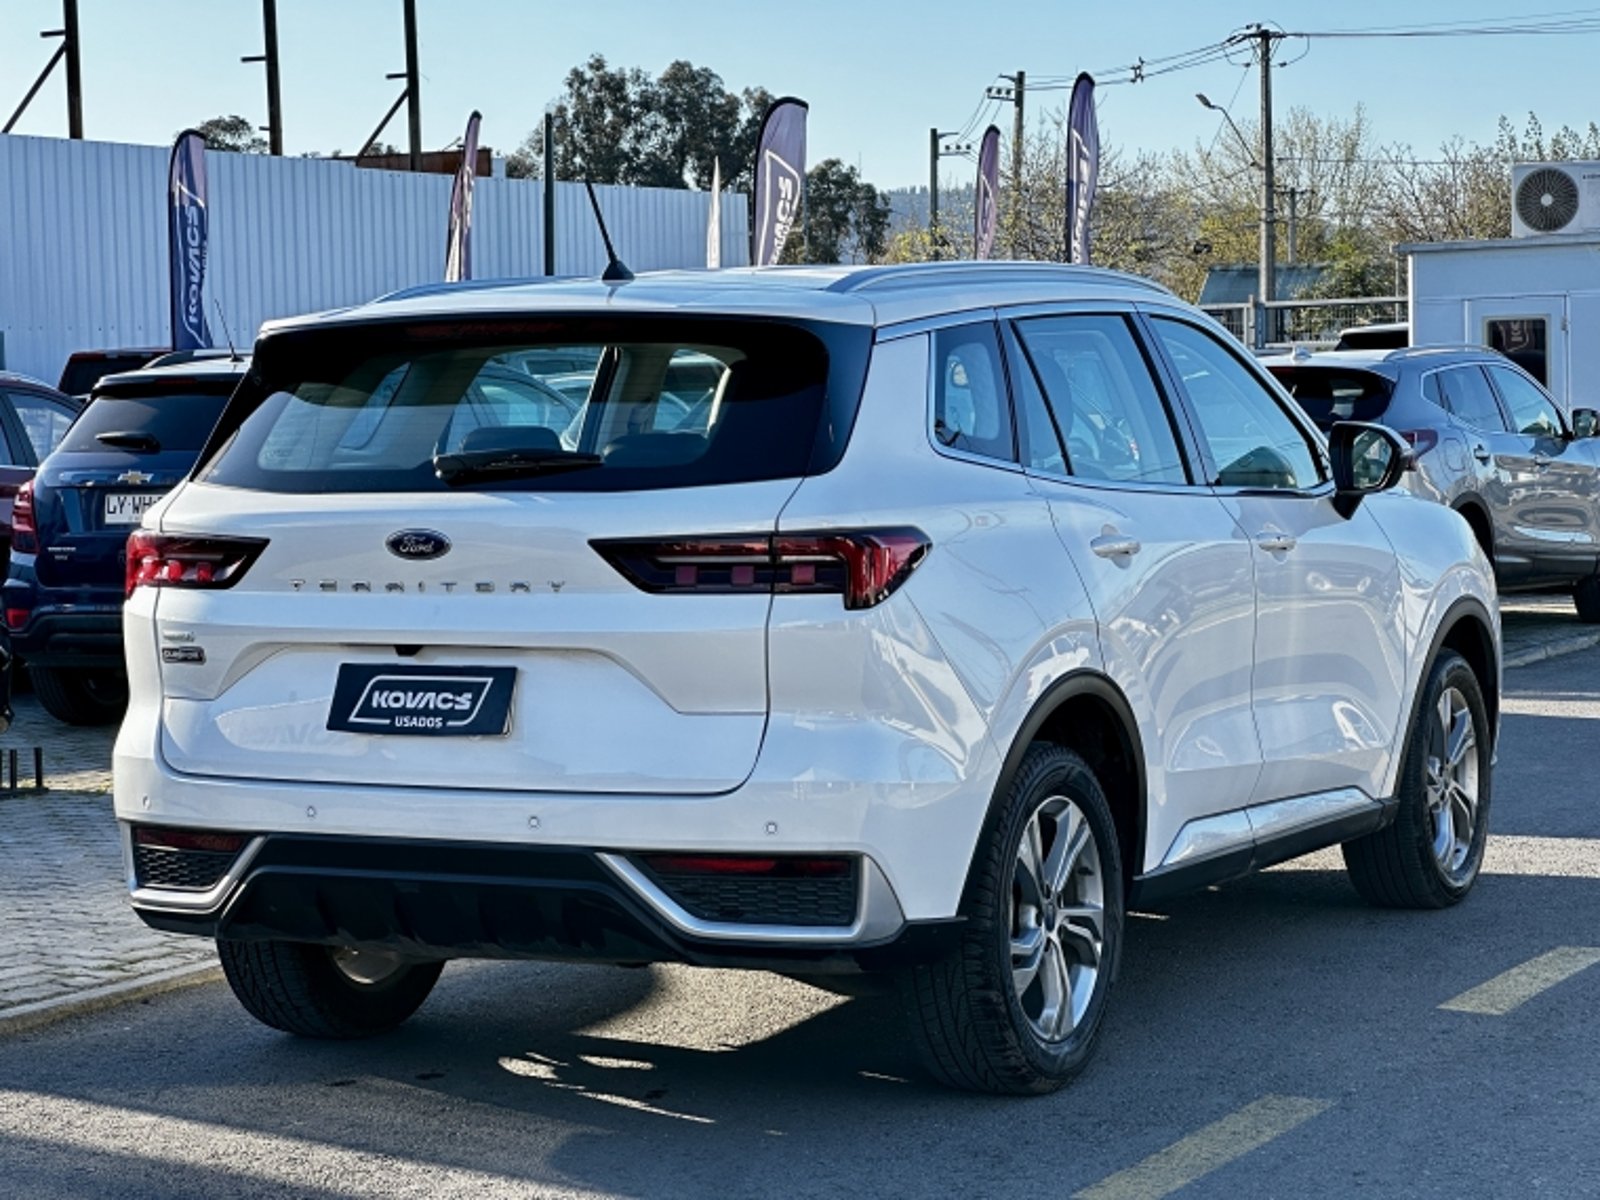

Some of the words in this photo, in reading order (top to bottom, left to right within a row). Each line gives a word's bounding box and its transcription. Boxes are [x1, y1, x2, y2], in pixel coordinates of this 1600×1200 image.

[185, 203, 201, 323] KOVACS
[289, 578, 566, 593] TERRITORY
[371, 690, 473, 711] KOVACS
[394, 715, 443, 729] USADOS
